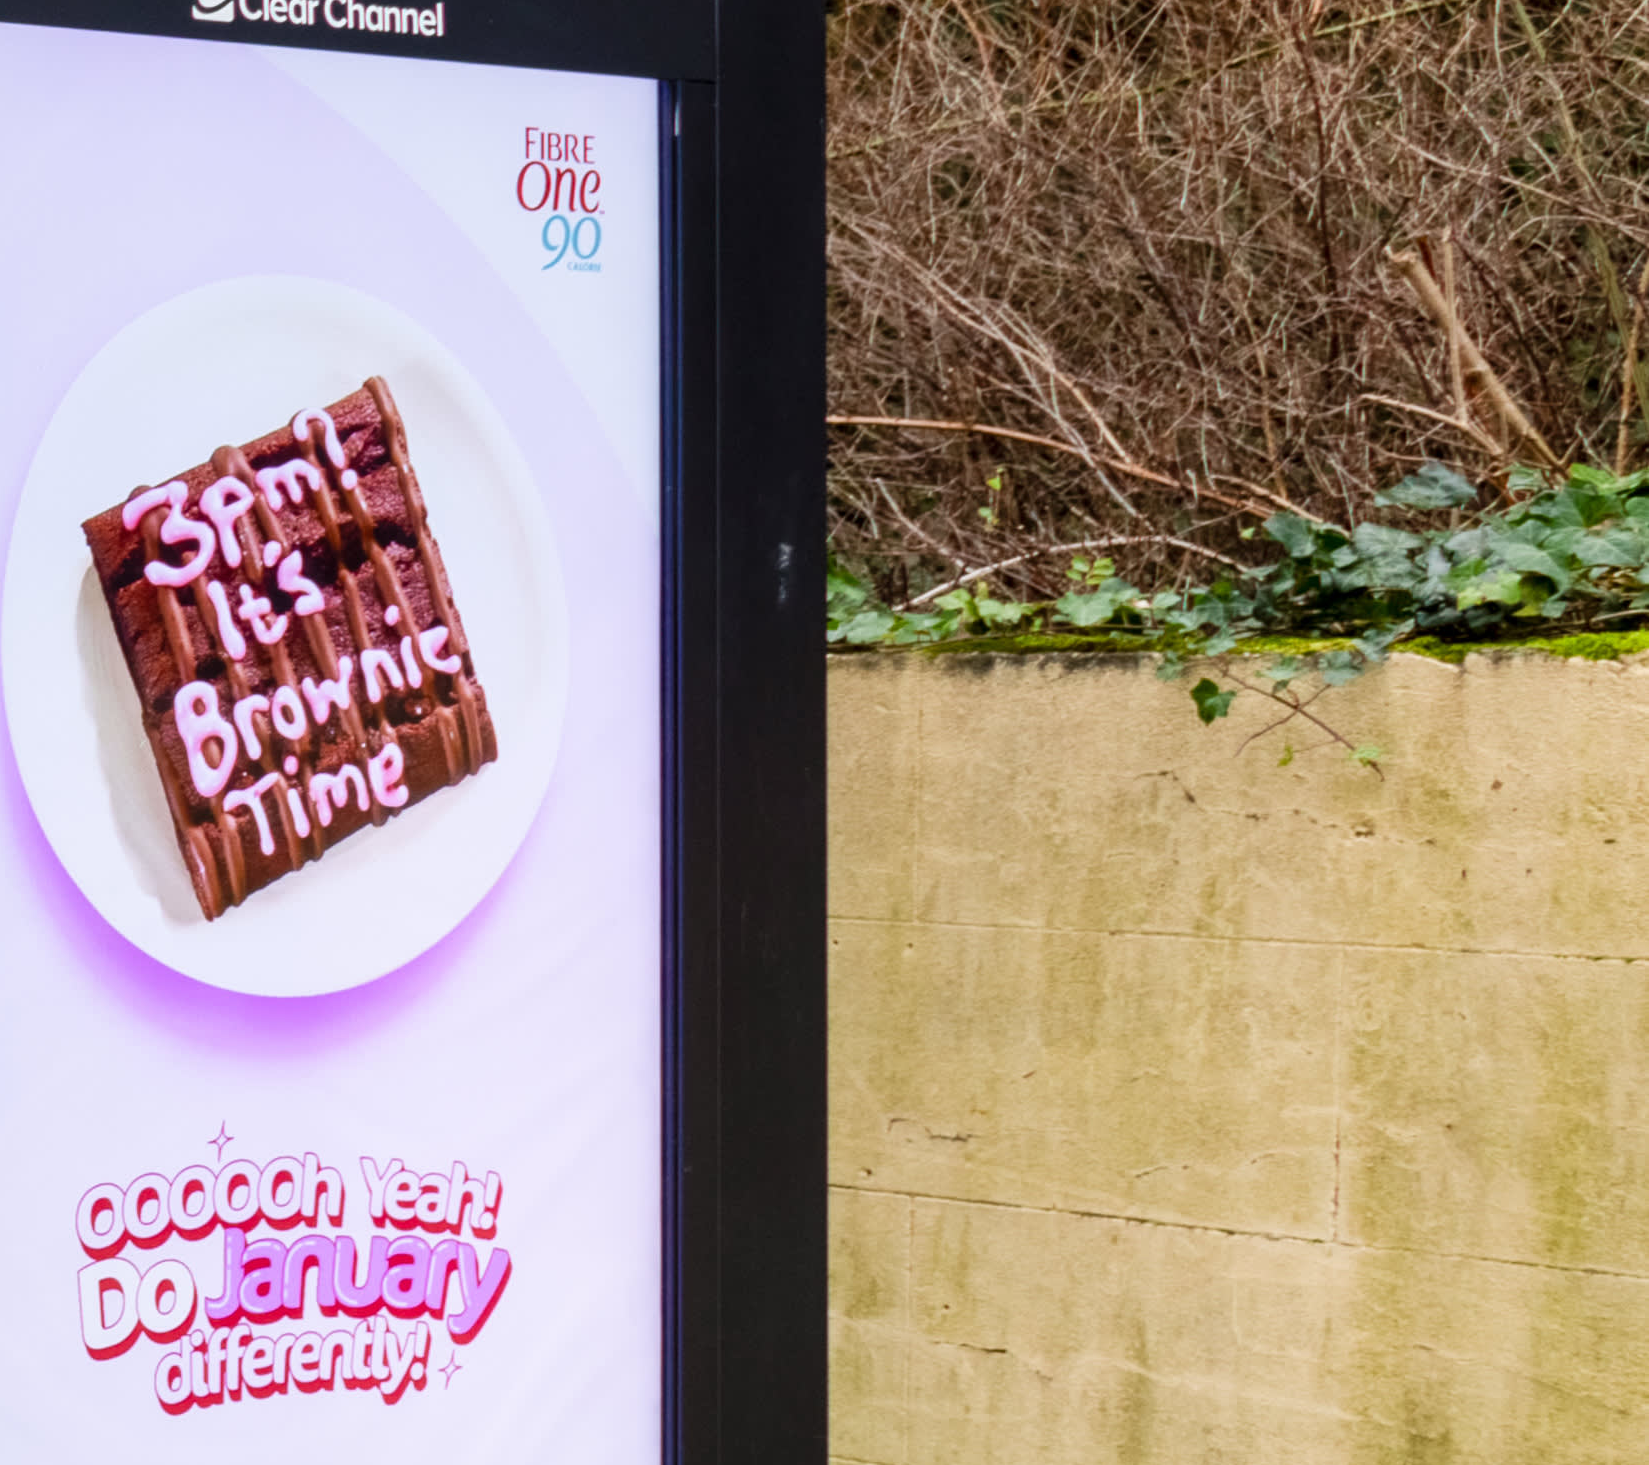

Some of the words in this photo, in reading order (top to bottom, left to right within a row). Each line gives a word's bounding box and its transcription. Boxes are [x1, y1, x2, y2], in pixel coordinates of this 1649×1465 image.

[517, 161, 601, 213] One
[525, 127, 595, 164] FIBRE
[541, 214, 601, 270] 90
[122, 407, 358, 588] 3pm?
[206, 541, 325, 660] It's
[174, 605, 461, 798] Brownie
[223, 741, 409, 856] Time
[359, 1156, 502, 1240] Yeah!
[77, 1257, 197, 1361] Do
[205, 1227, 511, 1345] January
[155, 1315, 431, 1416] differently!
